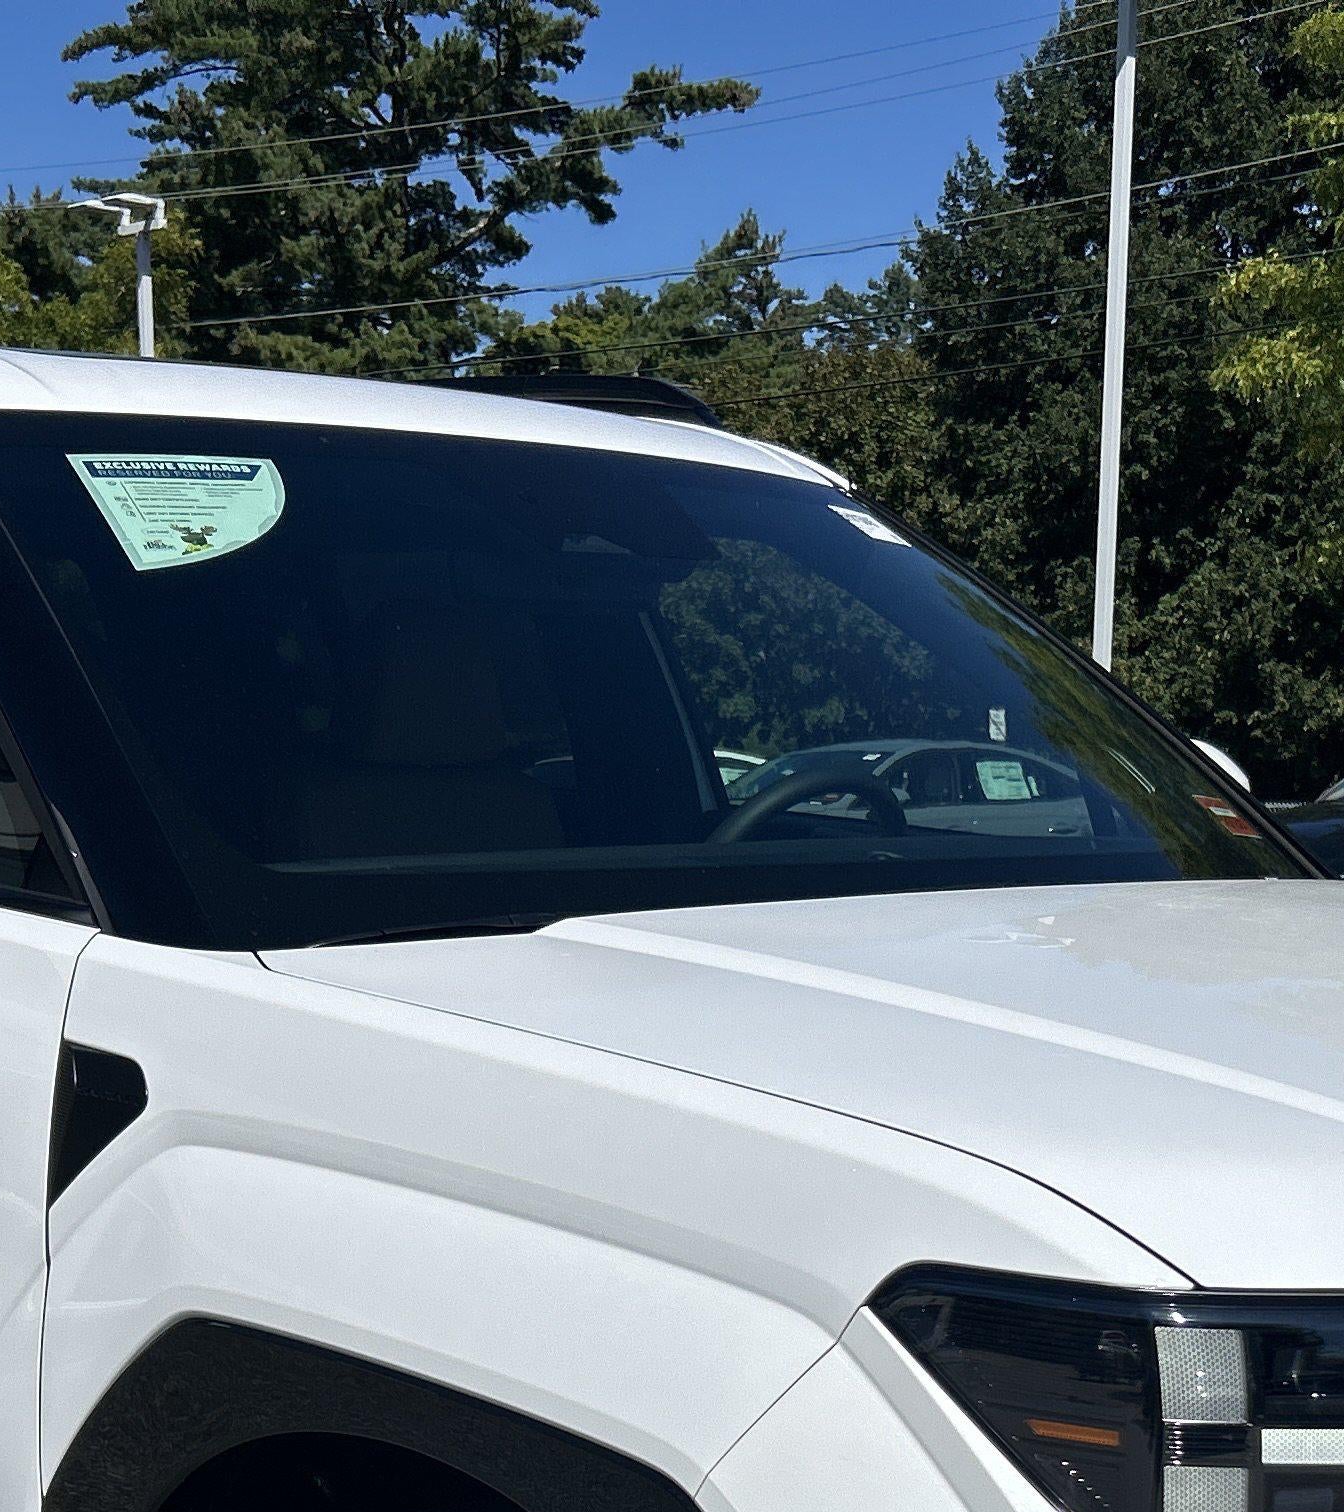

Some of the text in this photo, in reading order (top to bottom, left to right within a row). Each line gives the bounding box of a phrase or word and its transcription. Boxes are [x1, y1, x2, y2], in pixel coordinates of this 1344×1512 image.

[93, 461, 252, 473] EXCLUSIVE REWARDS
[173, 470, 201, 478] FOR
[204, 470, 232, 479] YOU
